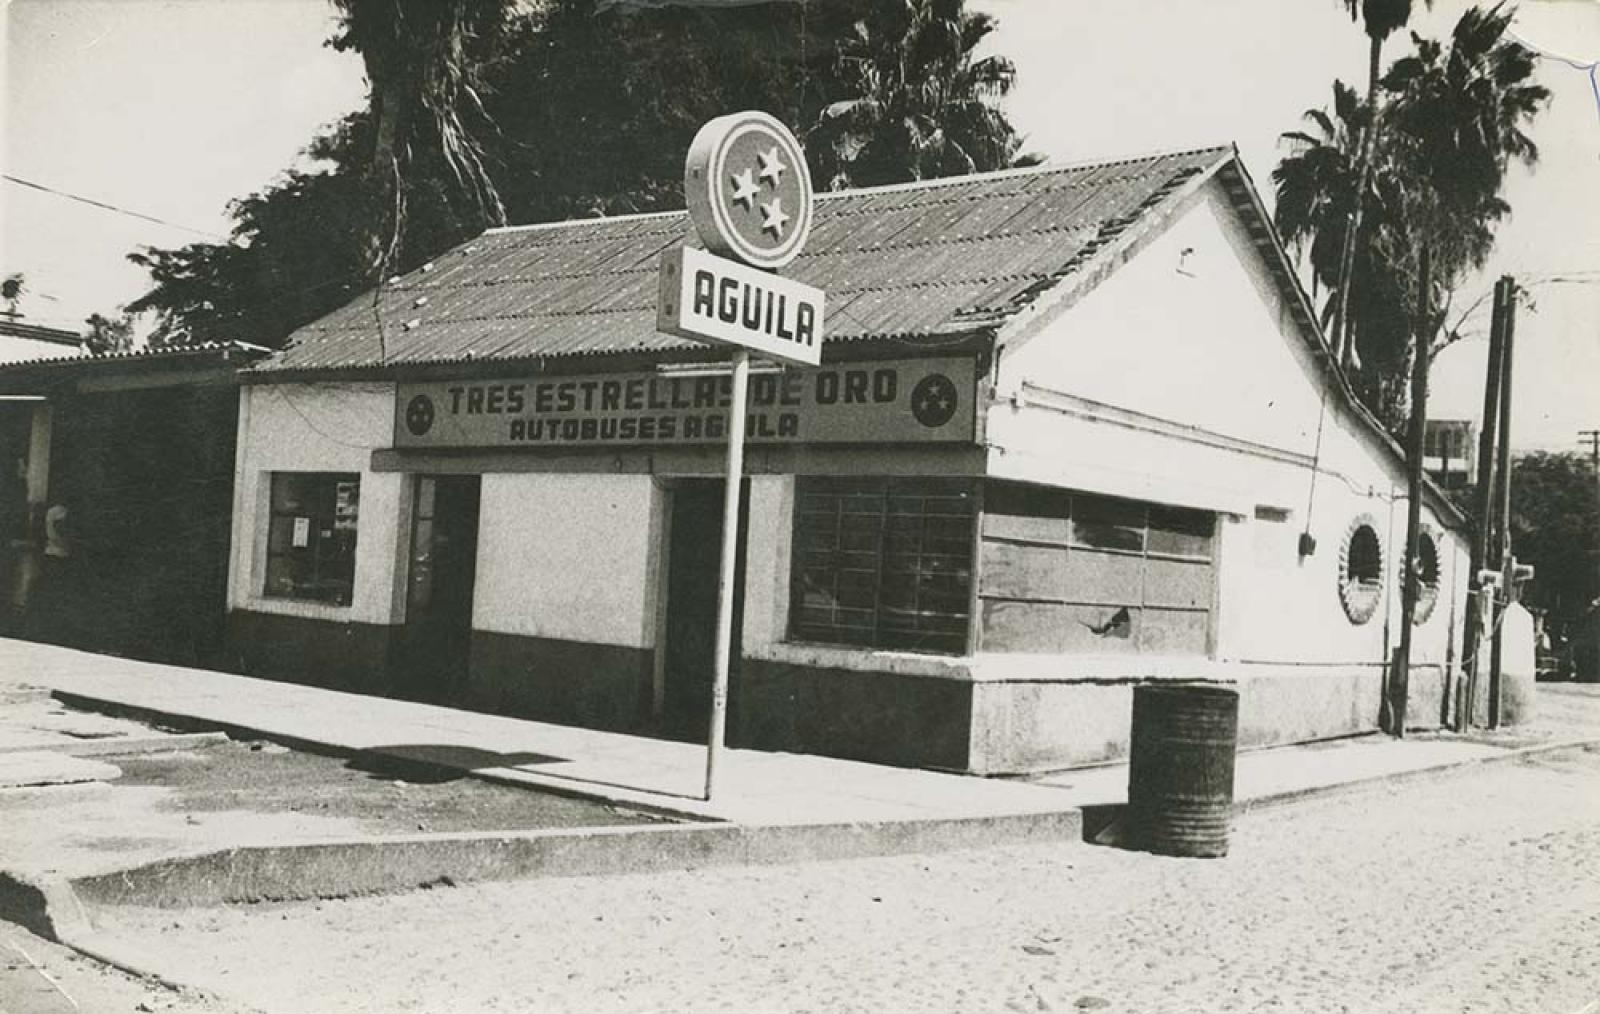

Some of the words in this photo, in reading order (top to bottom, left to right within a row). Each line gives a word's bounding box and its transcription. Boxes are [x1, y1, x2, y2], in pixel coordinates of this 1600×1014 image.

[693, 269, 815, 347] AGUILA
[448, 384, 525, 415] TRES
[535, 377, 733, 412] ESTRELLAS
[753, 371, 801, 404] DE
[814, 369, 897, 405] ORO
[510, 416, 676, 441] AUTOBUSES
[683, 412, 799, 438] AGILA
